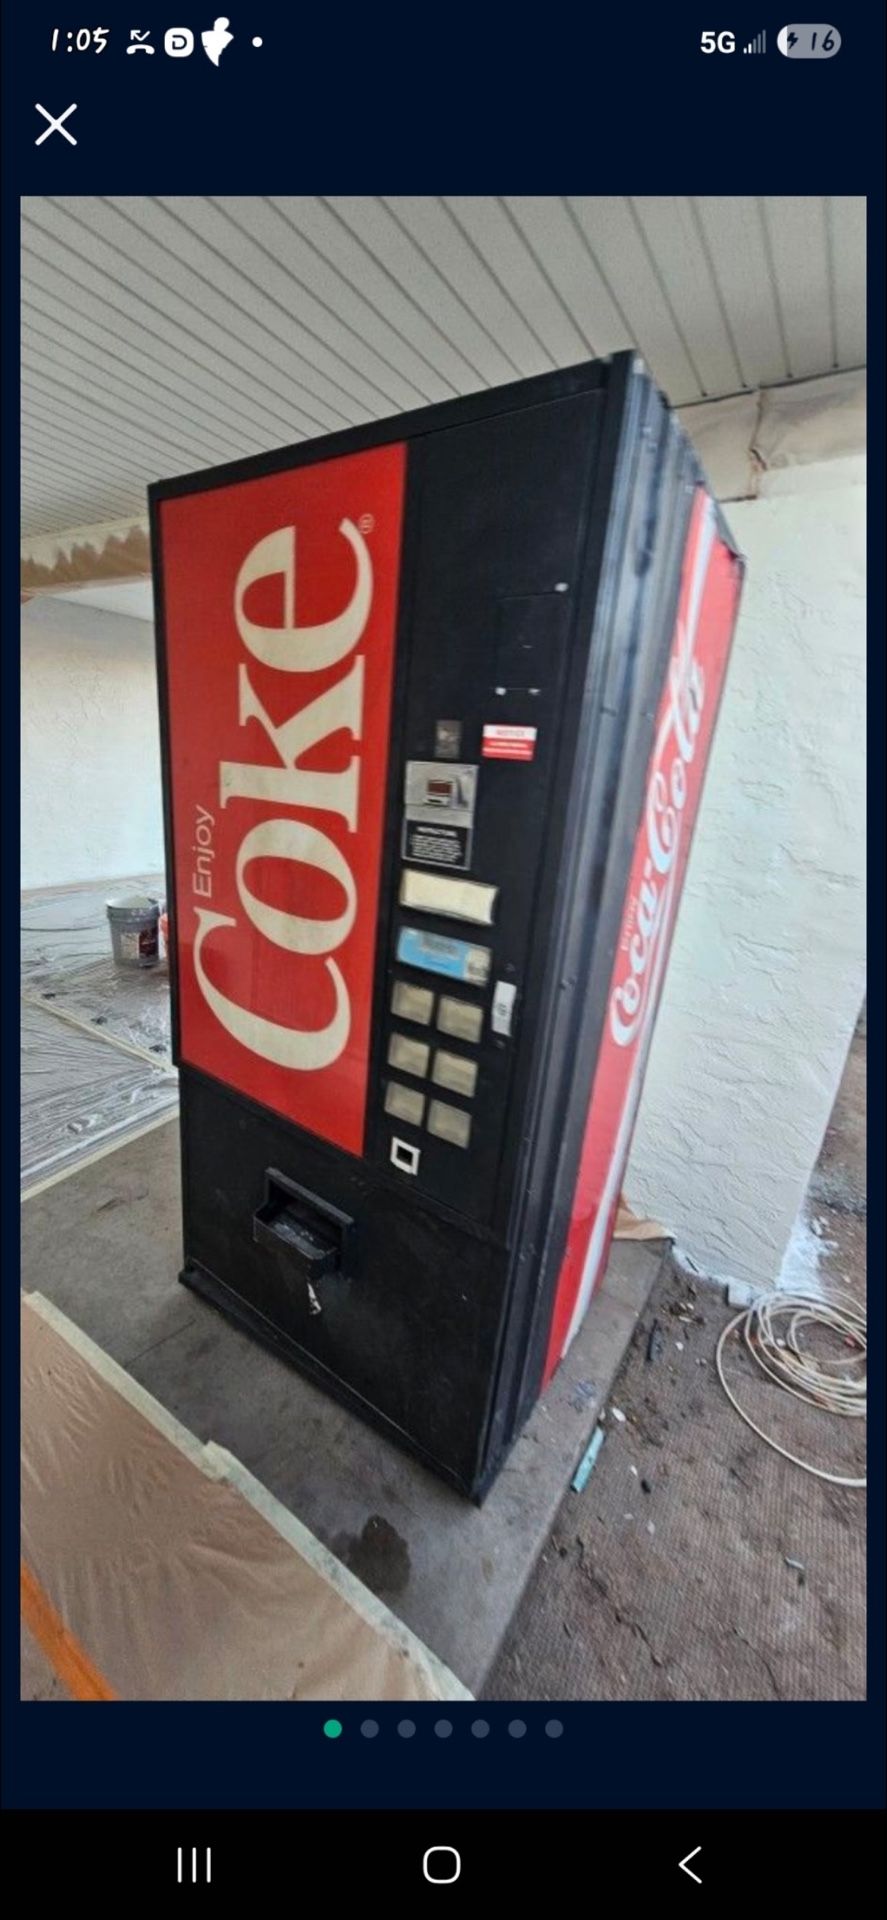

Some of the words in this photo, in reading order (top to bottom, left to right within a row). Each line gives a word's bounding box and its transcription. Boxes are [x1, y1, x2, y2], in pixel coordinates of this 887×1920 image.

[193, 804, 216, 899] Enjoy
[194, 516, 374, 1072] Coke
[610, 620, 704, 1047] Coca-Cola
